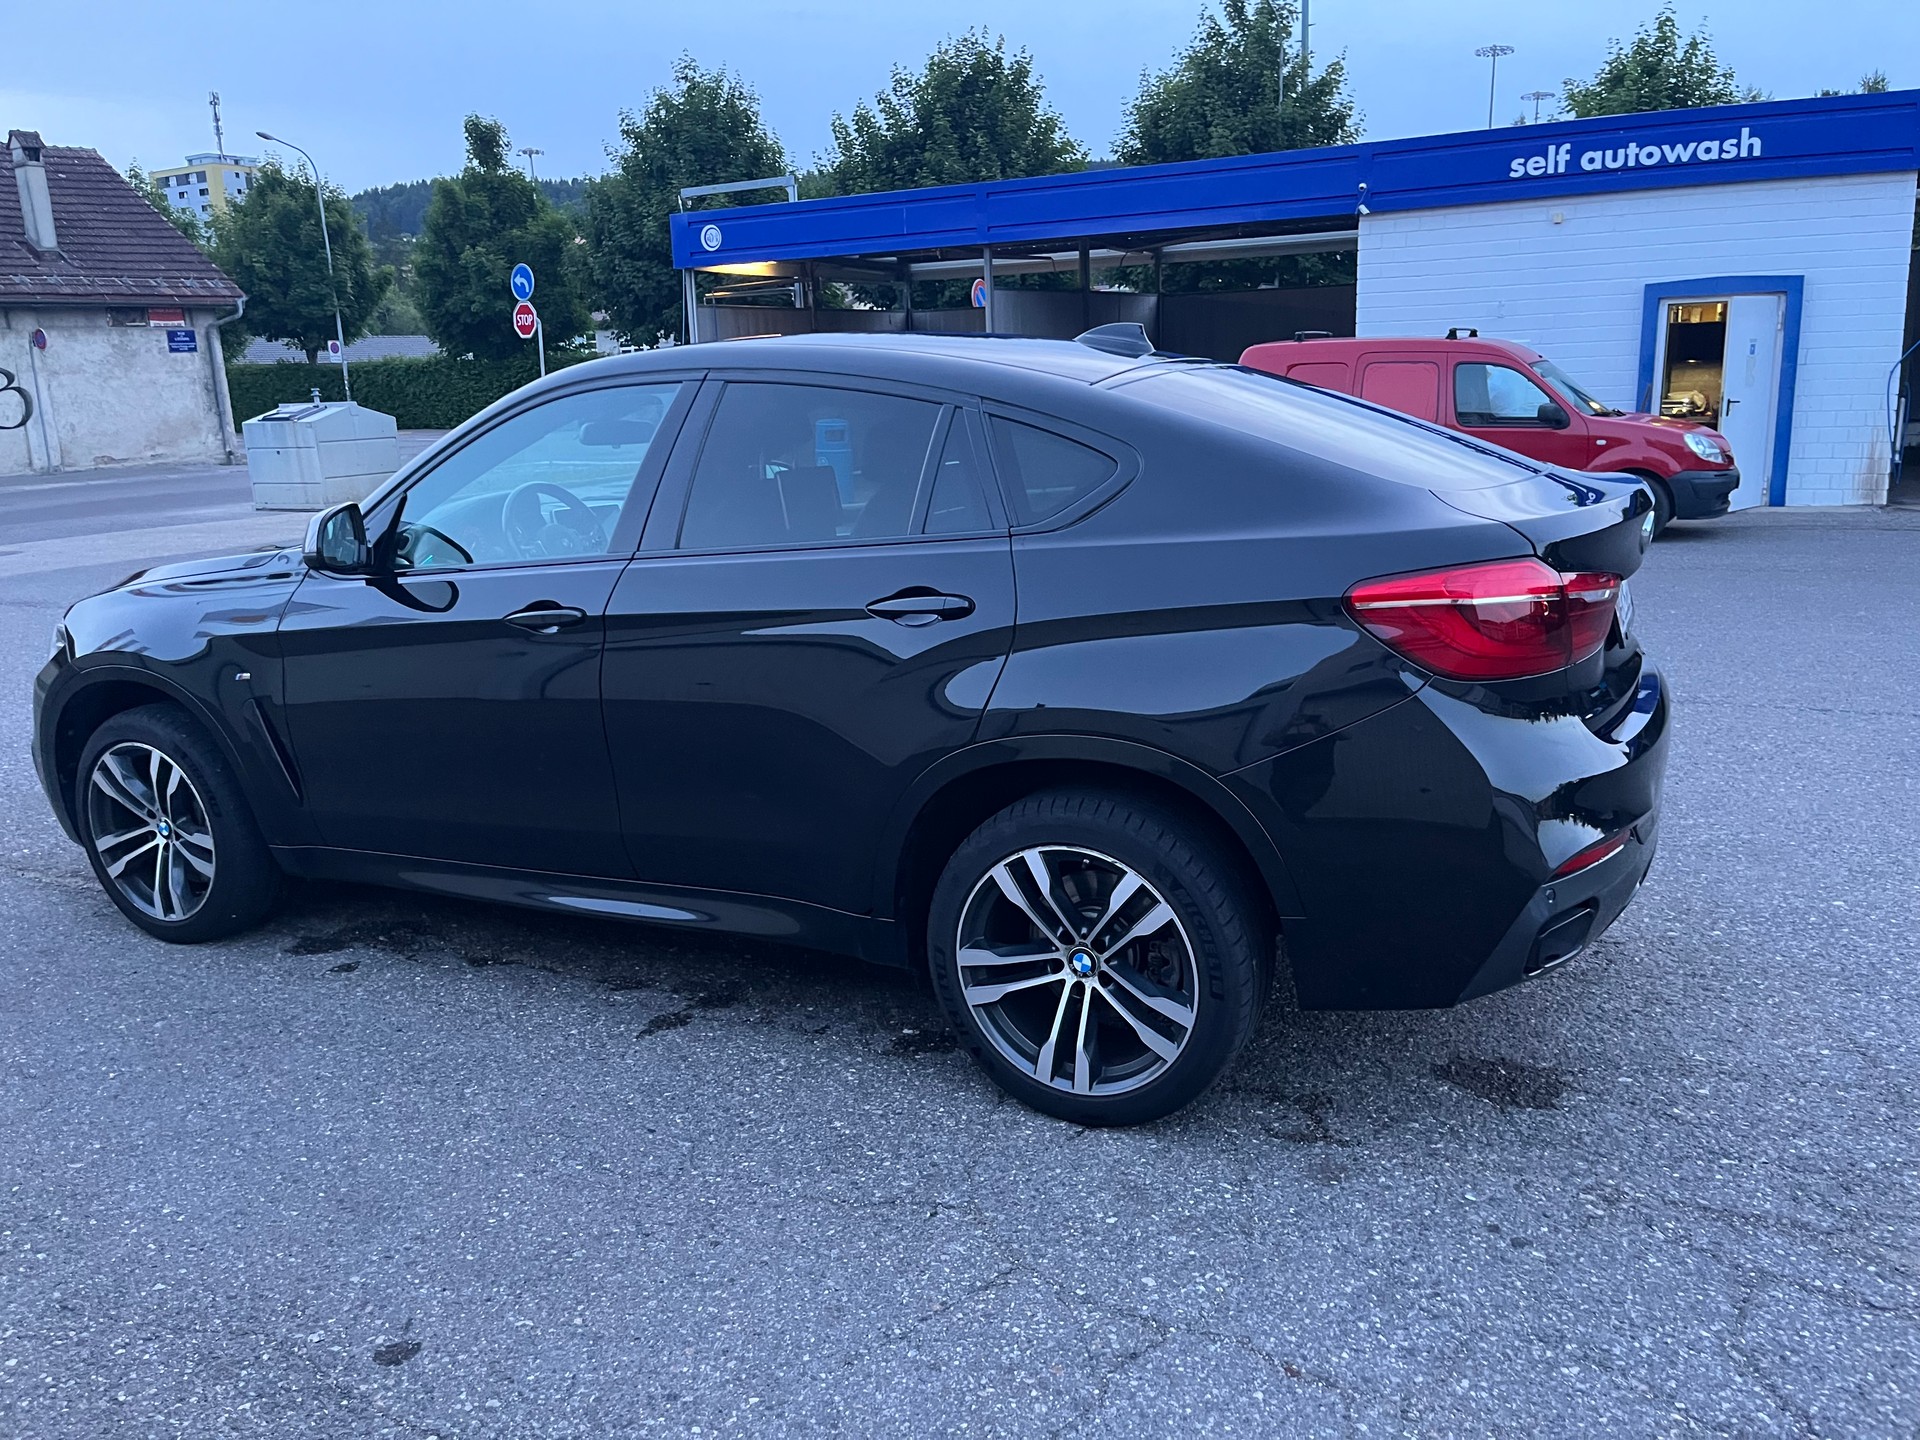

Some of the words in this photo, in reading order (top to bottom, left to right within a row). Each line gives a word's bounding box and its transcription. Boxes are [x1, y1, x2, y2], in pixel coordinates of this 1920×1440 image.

[1509, 143, 1571, 178] self
[1580, 127, 1762, 171] autowash
[517, 314, 533, 326] STOP
